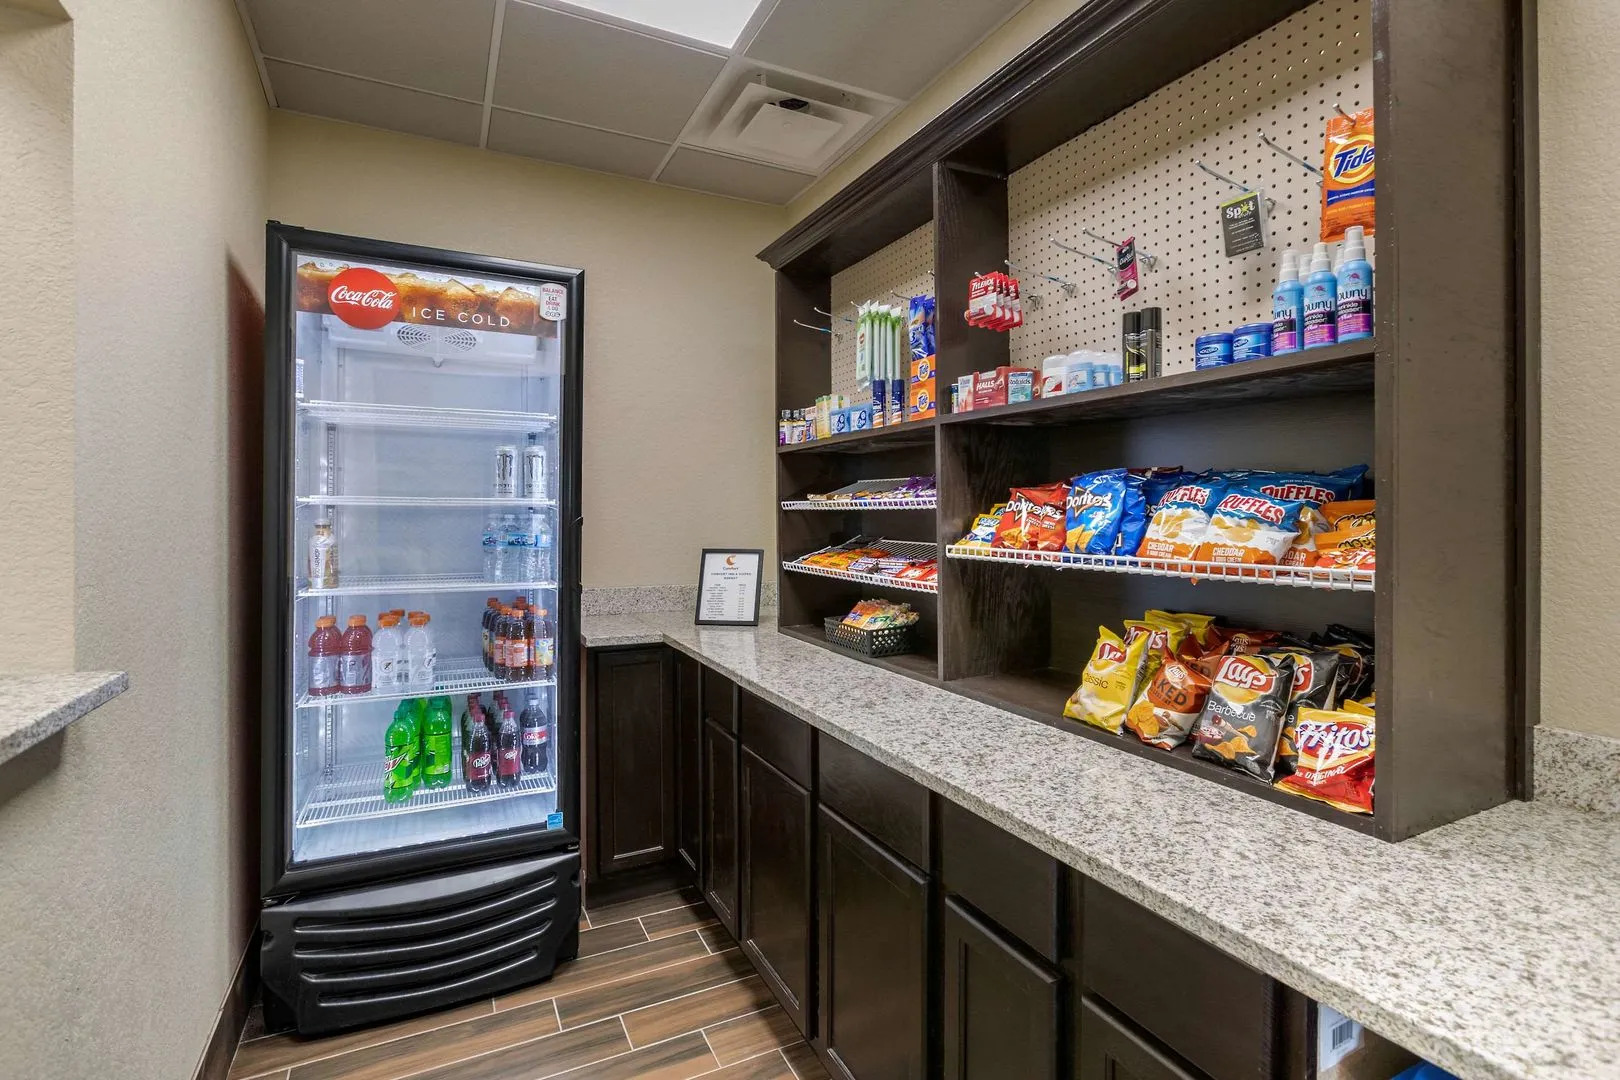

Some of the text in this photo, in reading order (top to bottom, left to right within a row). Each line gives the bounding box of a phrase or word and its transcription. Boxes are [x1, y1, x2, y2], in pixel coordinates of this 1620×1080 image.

[1333, 144, 1376, 178] Tide
[412, 306, 511, 327] ICE COLD
[976, 380, 996, 391] HALLS
[1067, 492, 1113, 510] Doritos
[1157, 486, 1211, 508] RUFFLES
[1217, 494, 1285, 525] RUFFLES
[1147, 541, 1174, 553] CHEDDAR
[1212, 547, 1245, 557] CHEDDAR
[1207, 700, 1257, 721] Barbecue
[1294, 720, 1375, 751] Fritos
